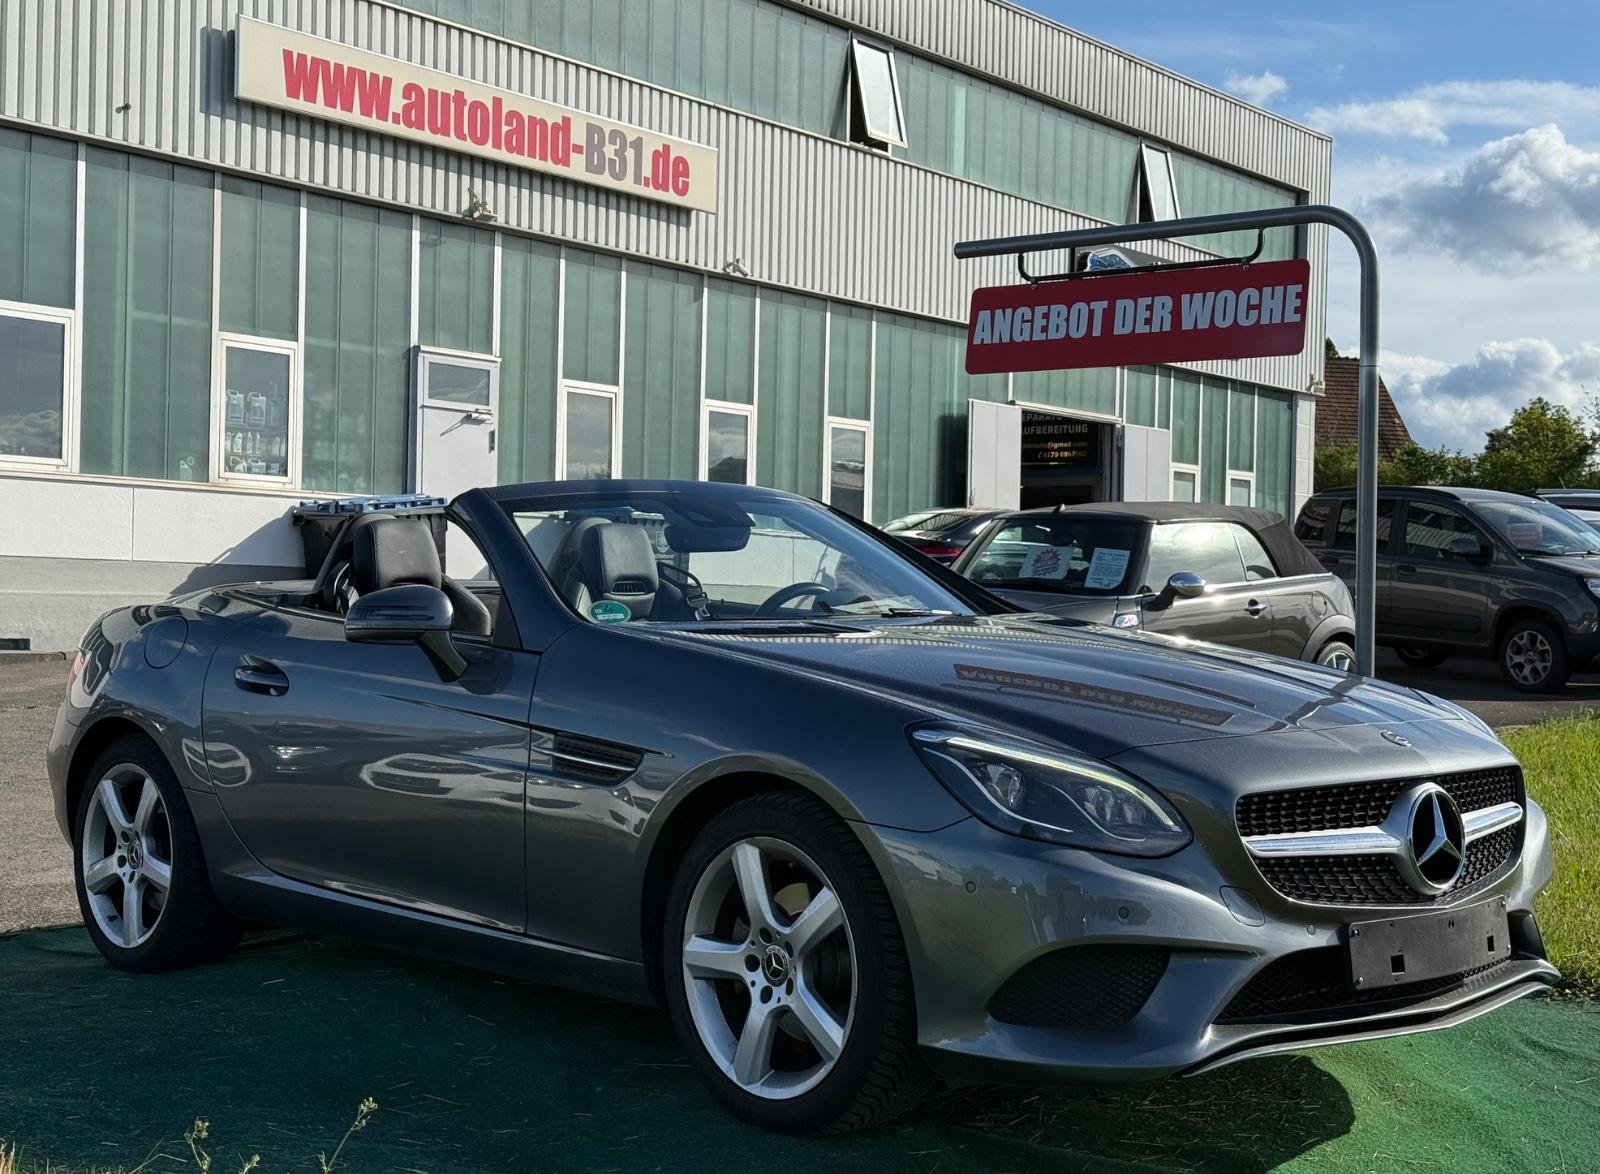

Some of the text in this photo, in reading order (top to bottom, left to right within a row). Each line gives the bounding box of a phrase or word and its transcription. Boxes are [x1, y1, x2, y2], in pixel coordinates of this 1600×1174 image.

[282, 48, 691, 198] www.autoland-B31.de
[972, 284, 1303, 345] ANGEBOT DER WOCHE
[1021, 424, 1088, 435] UFBEREITUNG
